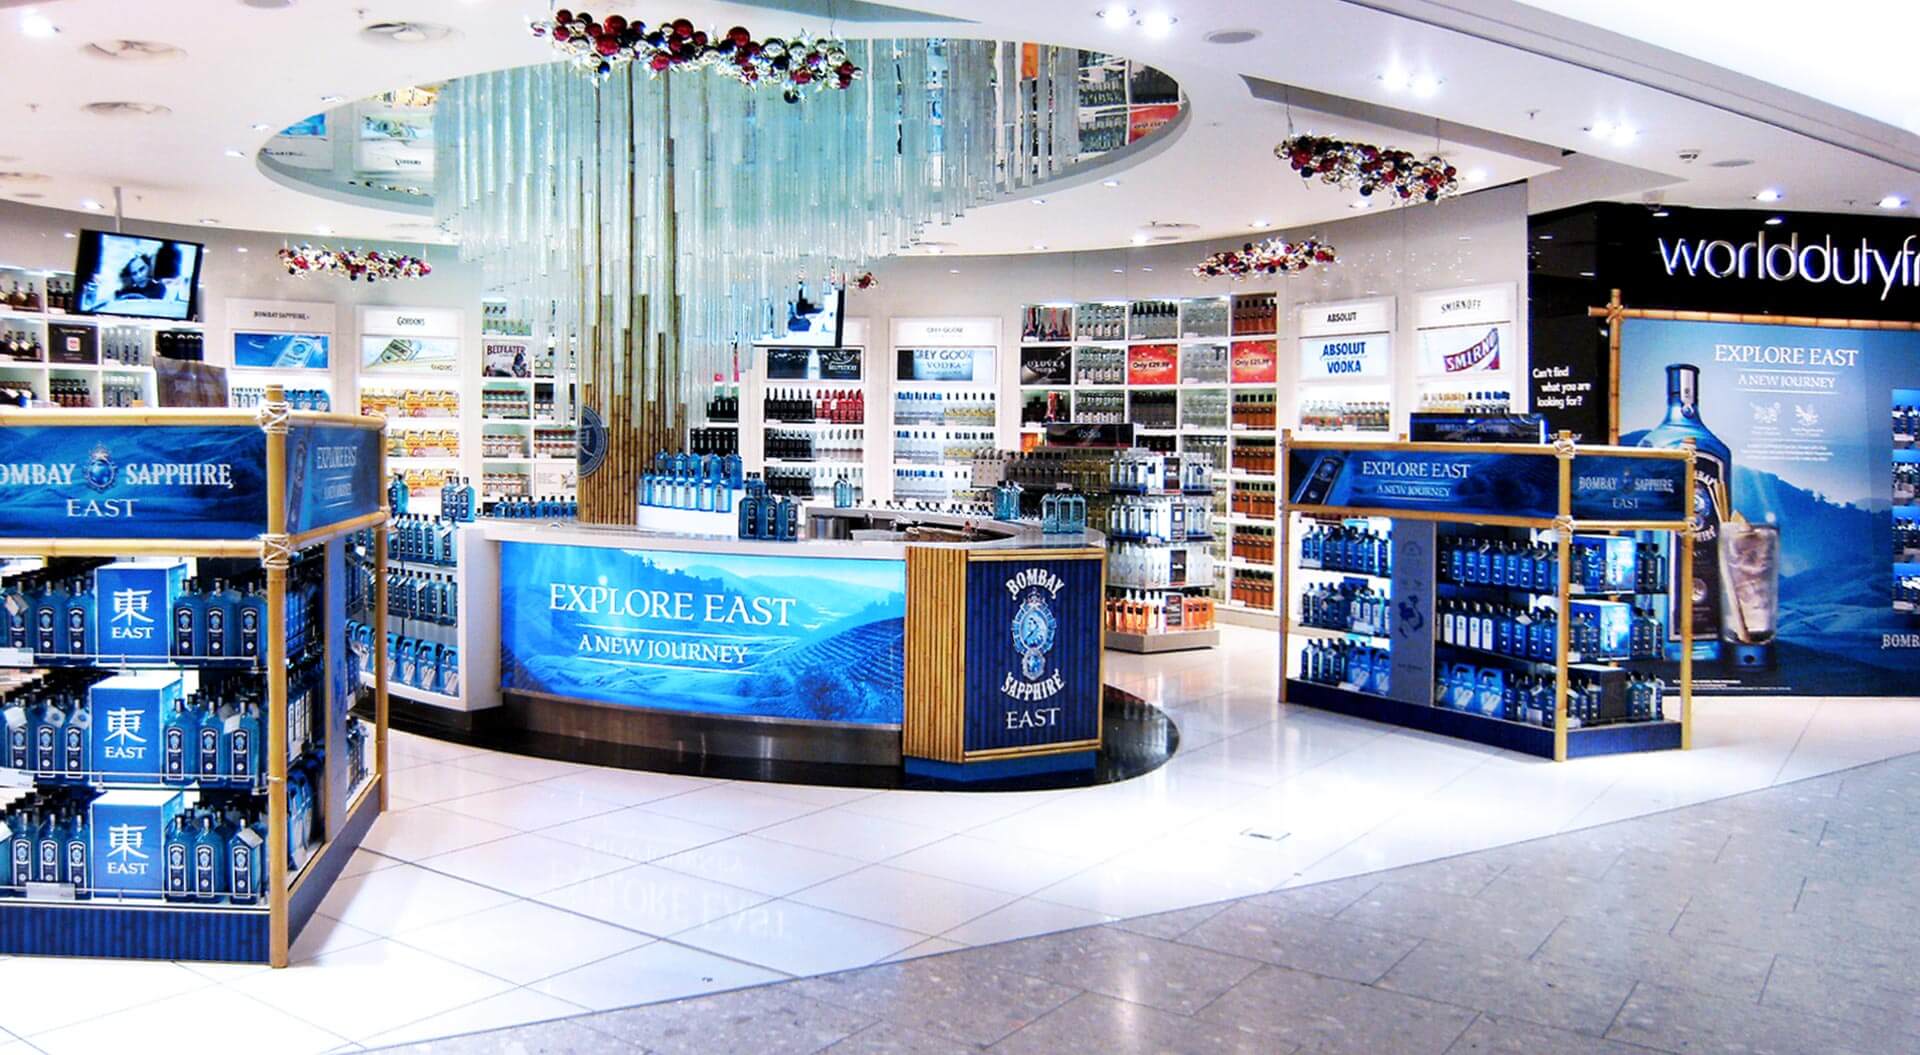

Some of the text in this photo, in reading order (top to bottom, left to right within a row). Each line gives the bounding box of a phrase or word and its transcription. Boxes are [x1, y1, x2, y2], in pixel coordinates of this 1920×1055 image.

[1327, 312, 1356, 323] ABSOLUT
[1322, 342, 1366, 356] ABSOLUT
[1714, 344, 1859, 367] EXPLORE EAST
[1327, 361, 1362, 373] VODKA
[1533, 366, 1569, 378] Can't find
[1541, 381, 1592, 394] what you are
[1749, 375, 1779, 386] NEW
[1780, 376, 1836, 389] JOURNEY
[1537, 395, 1583, 409] looking for?
[126, 464, 234, 488] SAPPHIRE
[1362, 461, 1470, 479] EXPLORE EAST
[1578, 476, 1674, 493] BOMBAY SAPPHIRE
[66, 498, 140, 517] EAST
[1612, 497, 1639, 509] EAST
[1005, 568, 1065, 600] BOMBAY
[111, 588, 155, 626] 東
[549, 583, 796, 626] EXPLORE EAST
[111, 626, 154, 638] EAST
[578, 634, 748, 664] A NEW JOURNEY
[1880, 634, 1920, 649] BOMB
[1001, 668, 1065, 701] SAPPHIRE
[104, 707, 147, 745] 東
[1006, 707, 1061, 729] EAST
[104, 746, 147, 759] EAST
[106, 823, 149, 861] 東
[107, 861, 149, 874] EAST
